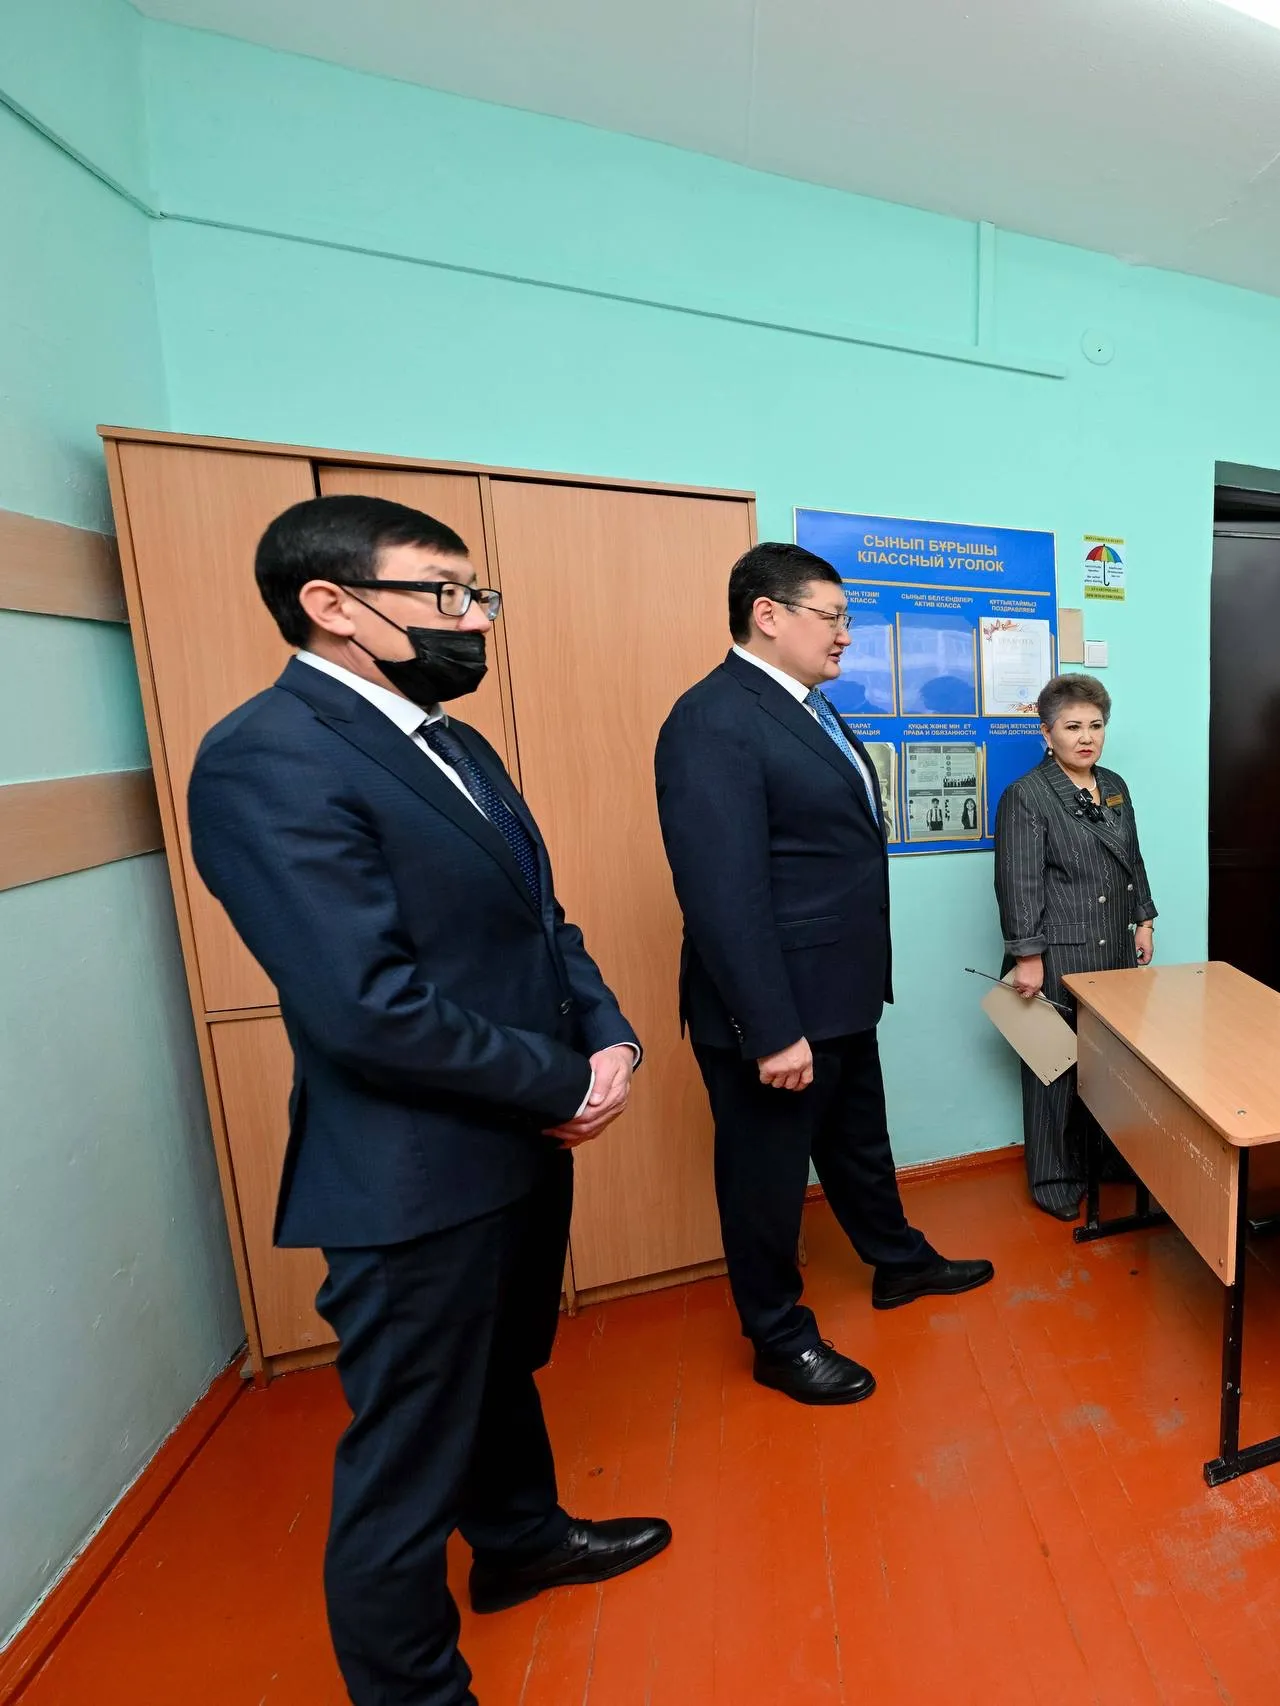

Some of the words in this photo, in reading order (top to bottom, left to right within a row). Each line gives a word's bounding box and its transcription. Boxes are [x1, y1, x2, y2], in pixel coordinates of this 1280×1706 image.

[863, 534, 925, 551] СЫНЫП
[929, 540, 998, 557] БҰРЫШЫ
[857, 551, 945, 568] КЛАССНЫЙ
[948, 557, 1004, 572] УГОЛОК
